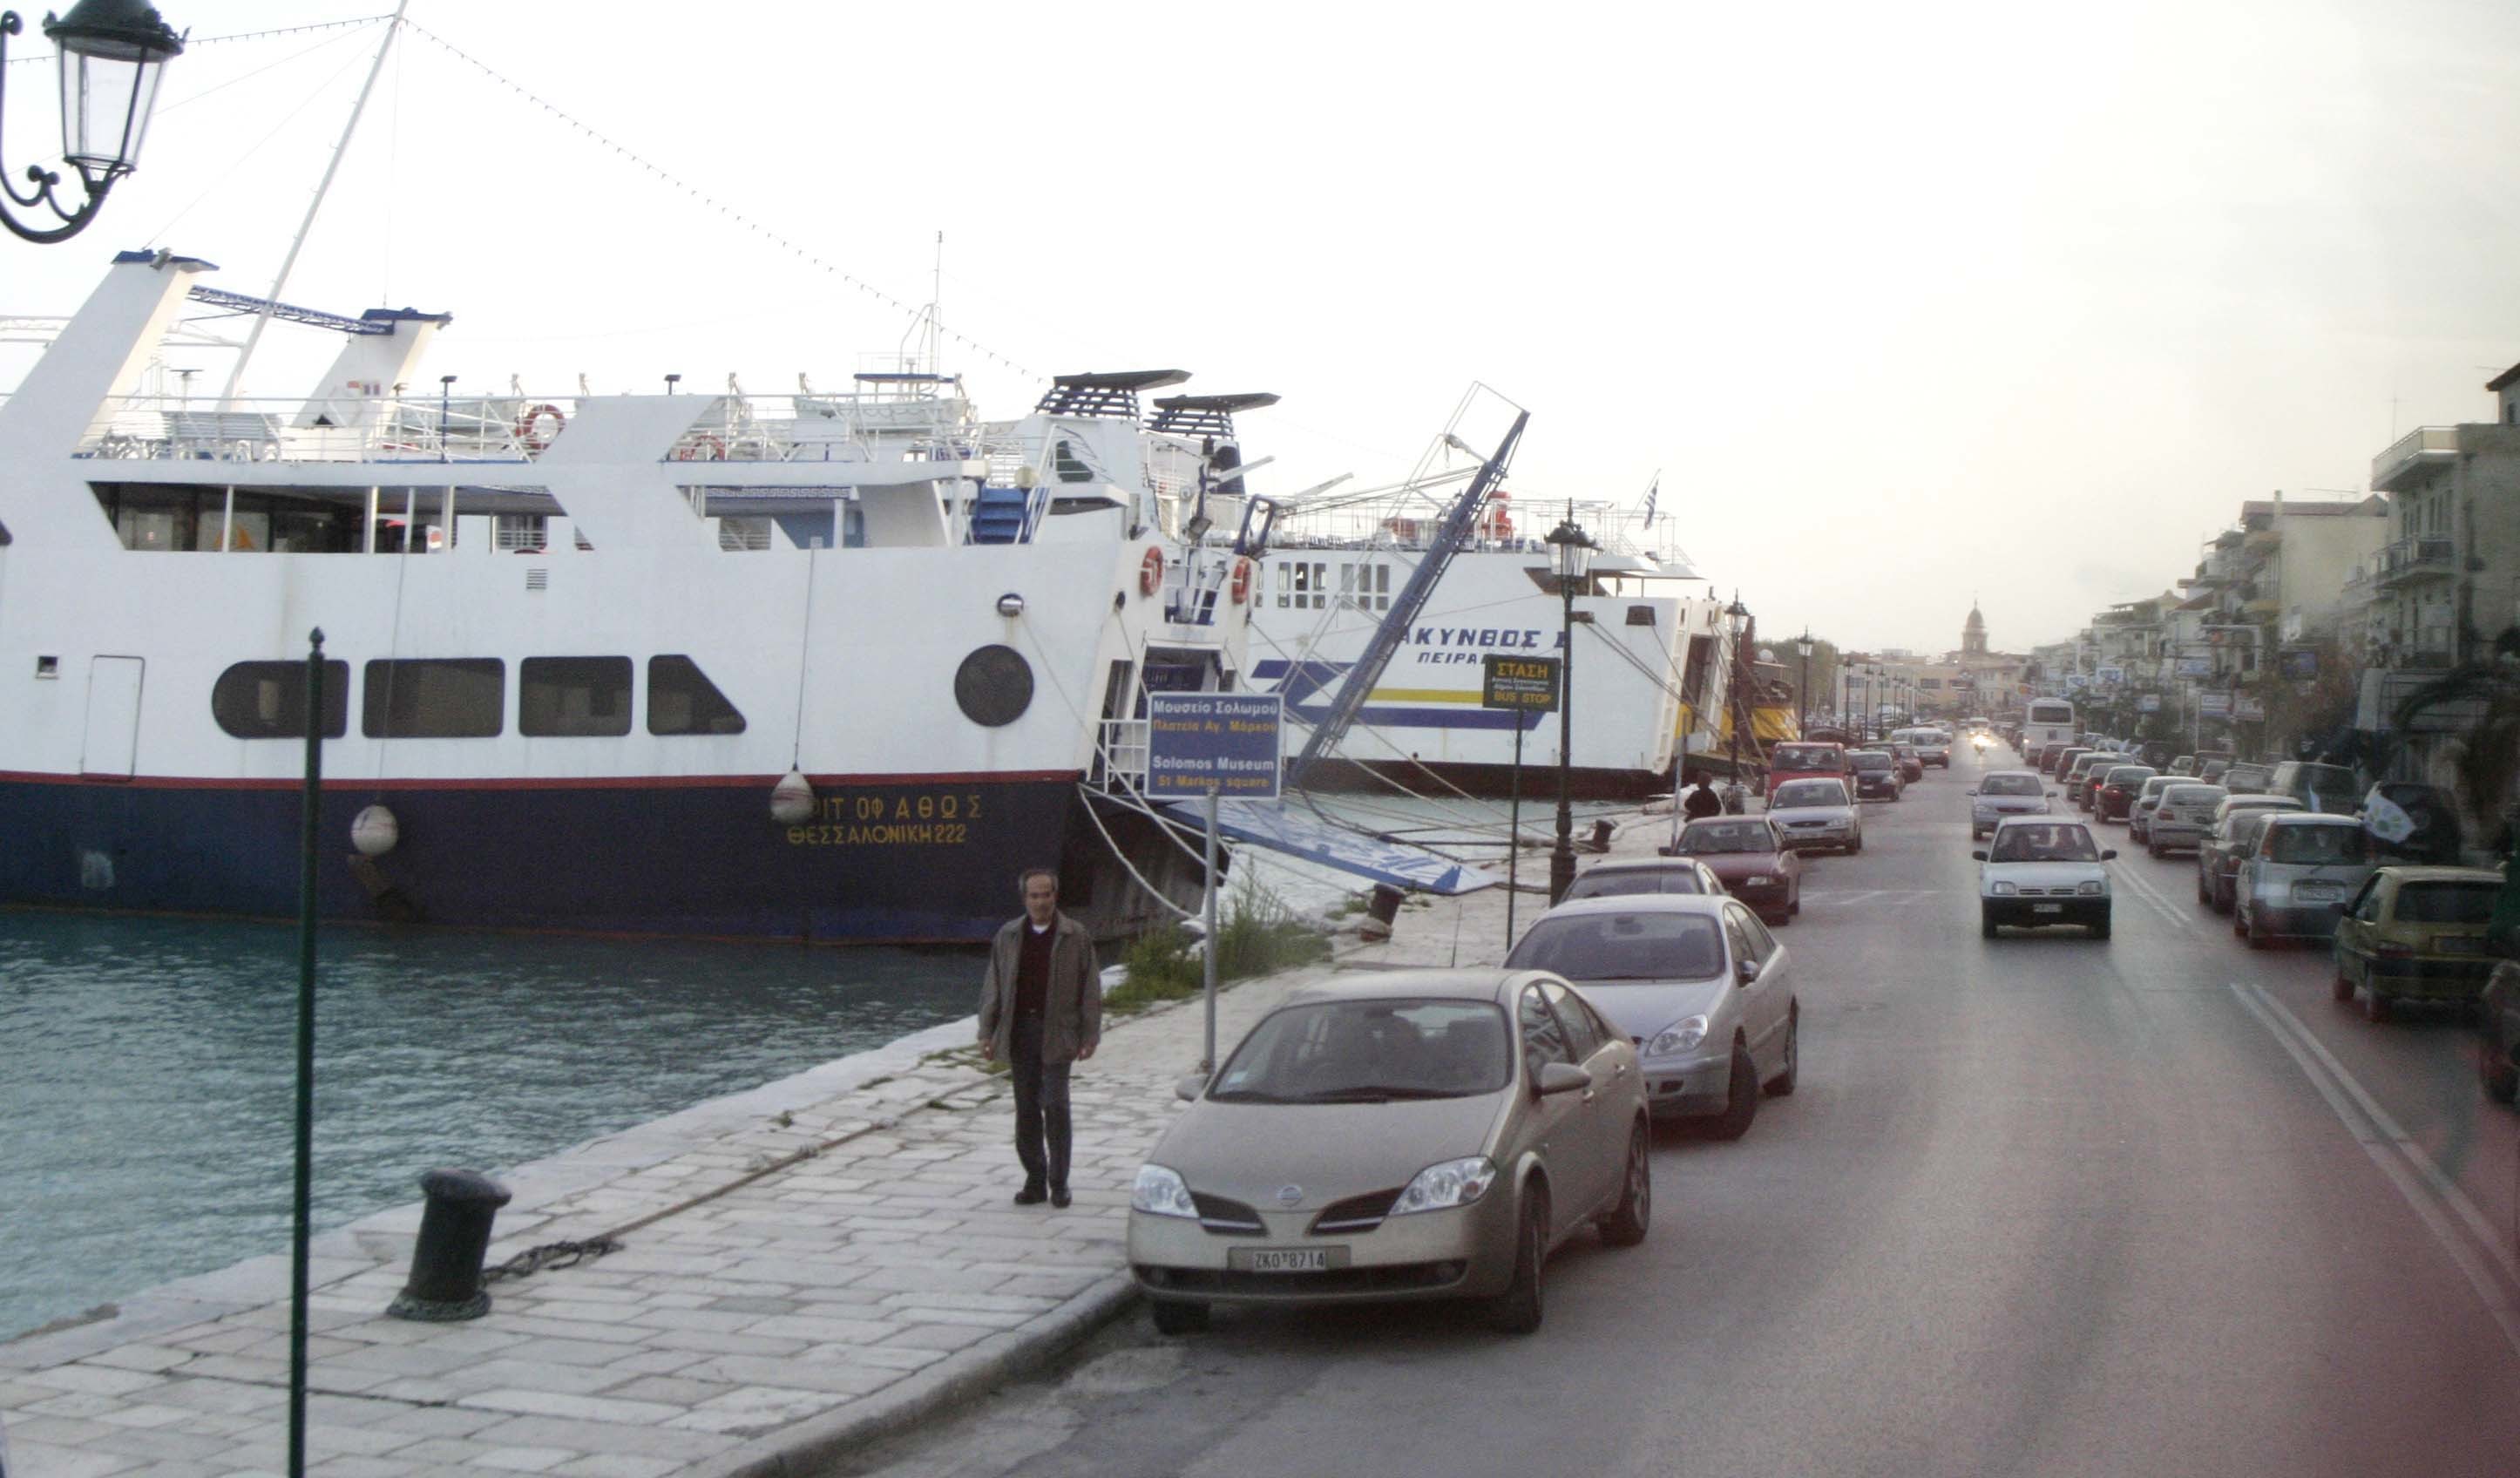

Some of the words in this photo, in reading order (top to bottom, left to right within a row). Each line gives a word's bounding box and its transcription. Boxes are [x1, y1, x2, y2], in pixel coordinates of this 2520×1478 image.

[1497, 661, 1548, 678] ΣΤΑΣΗ
[1494, 691, 1517, 703] BUS
[1521, 693, 1552, 704] STOP
[1153, 700, 1211, 714] Μουσείο
[1216, 701, 1278, 716] Σολωμού
[1152, 755, 1213, 770] Solomos
[1217, 756, 1275, 771] Museum
